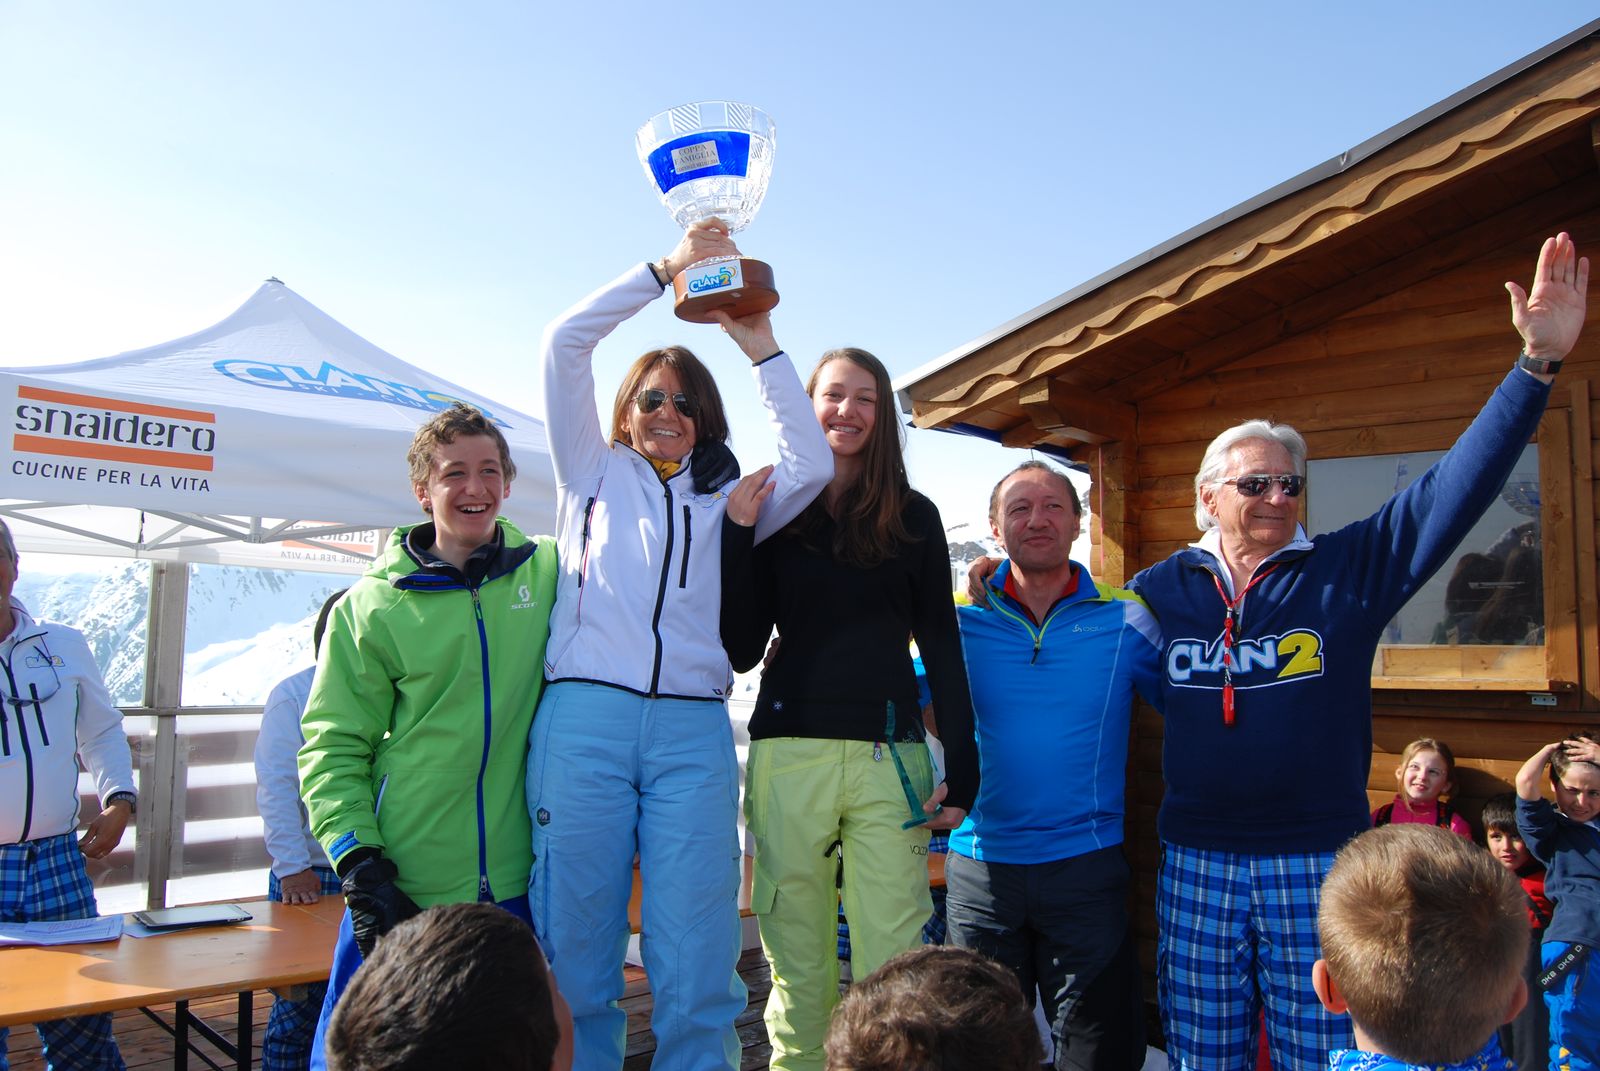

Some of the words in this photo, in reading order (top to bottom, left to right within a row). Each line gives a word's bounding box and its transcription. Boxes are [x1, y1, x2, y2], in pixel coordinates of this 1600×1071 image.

[679, 144, 707, 155] COPPA
[689, 272, 731, 292] CLAN2
[15, 404, 216, 452] snaidero
[12, 460, 88, 481] CUCINE
[96, 468, 131, 485] PER
[140, 473, 161, 488] LA
[171, 476, 210, 492] VITA
[1167, 632, 1321, 681] CLAN2
